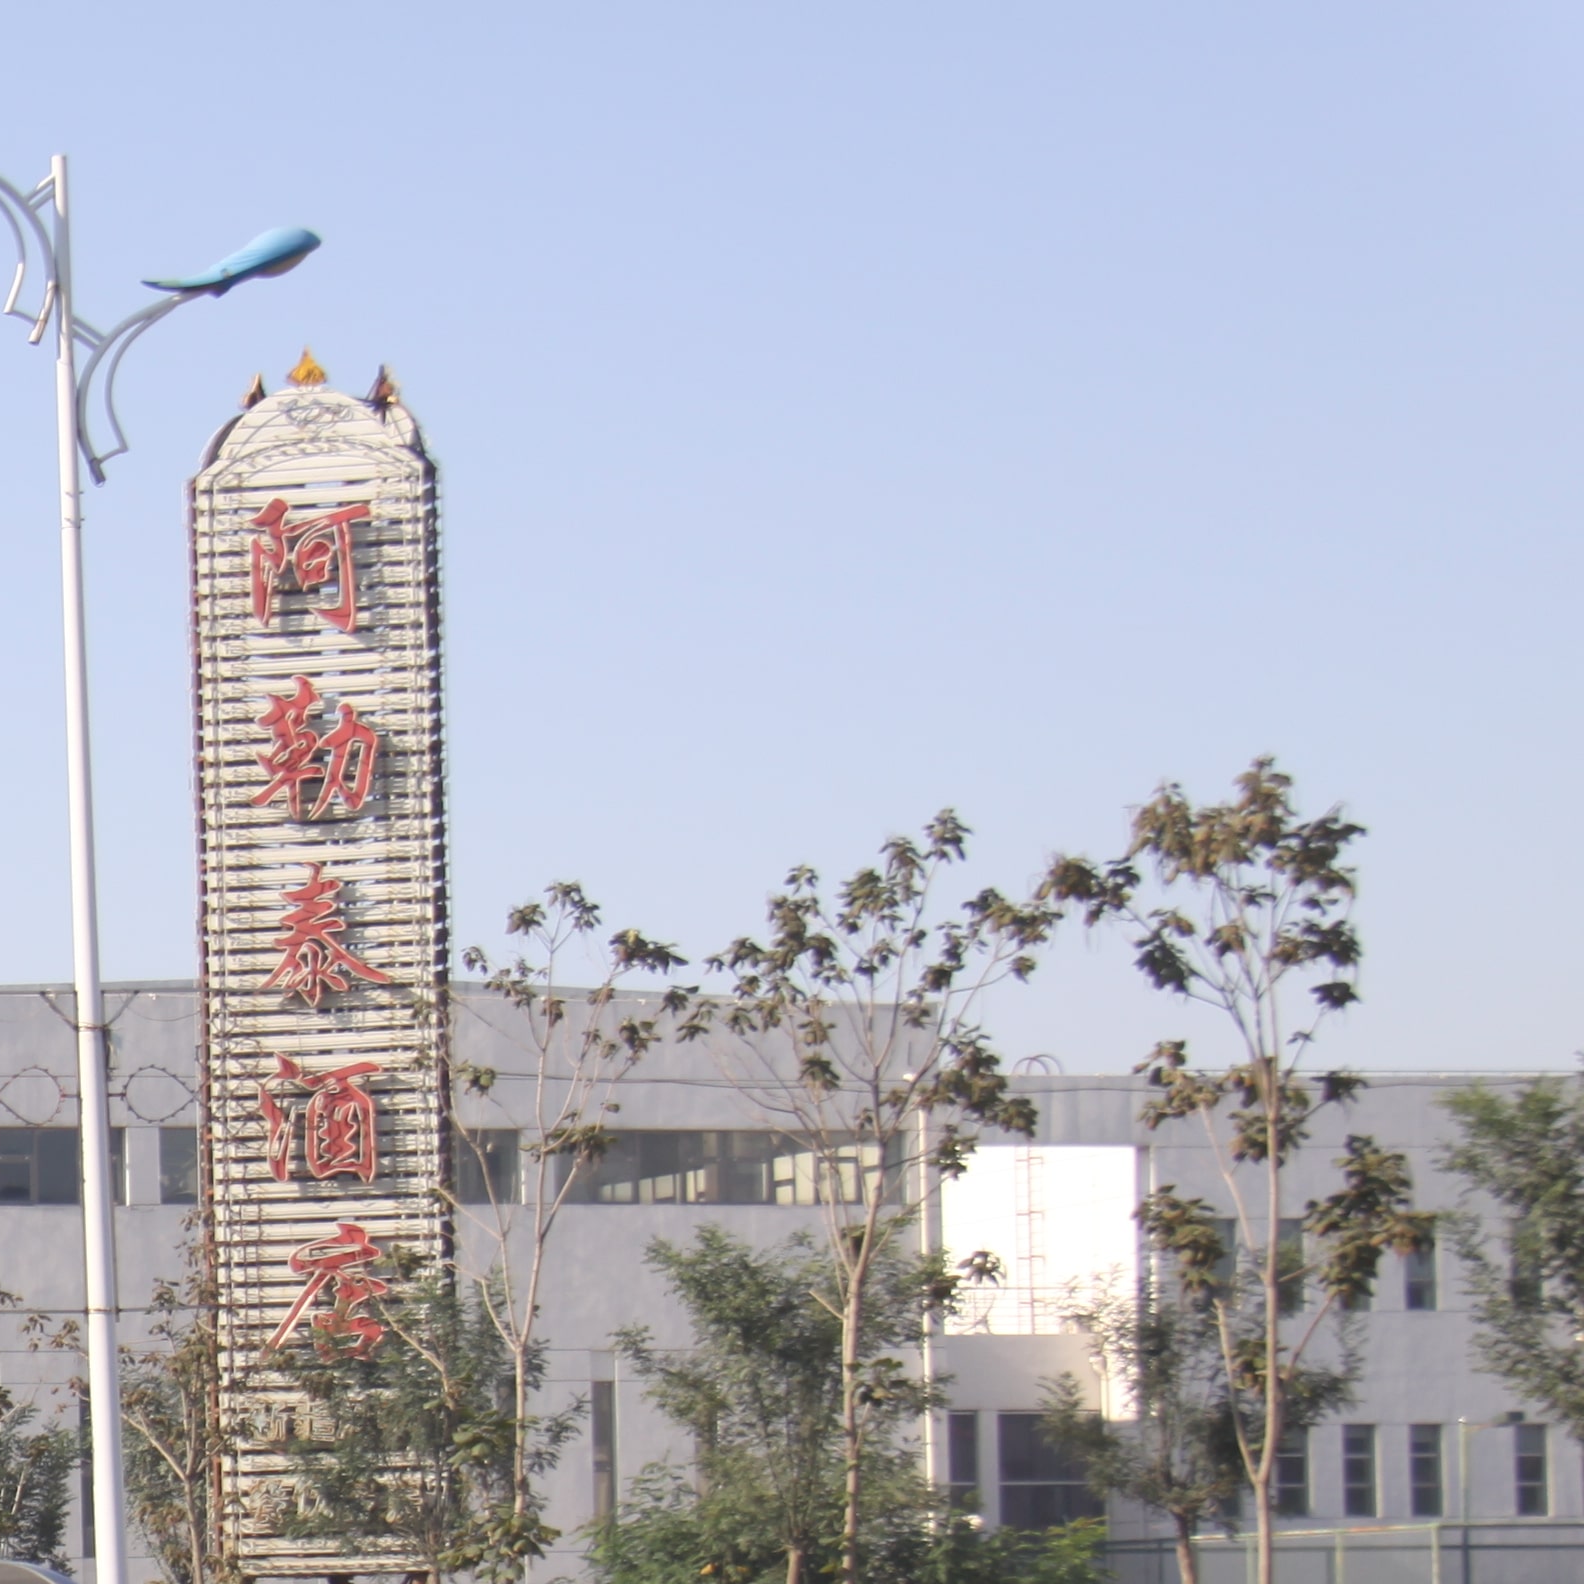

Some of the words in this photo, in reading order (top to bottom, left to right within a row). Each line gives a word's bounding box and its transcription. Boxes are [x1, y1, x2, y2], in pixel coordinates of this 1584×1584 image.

[250, 496, 391, 1362] 阿勒泰酒店
